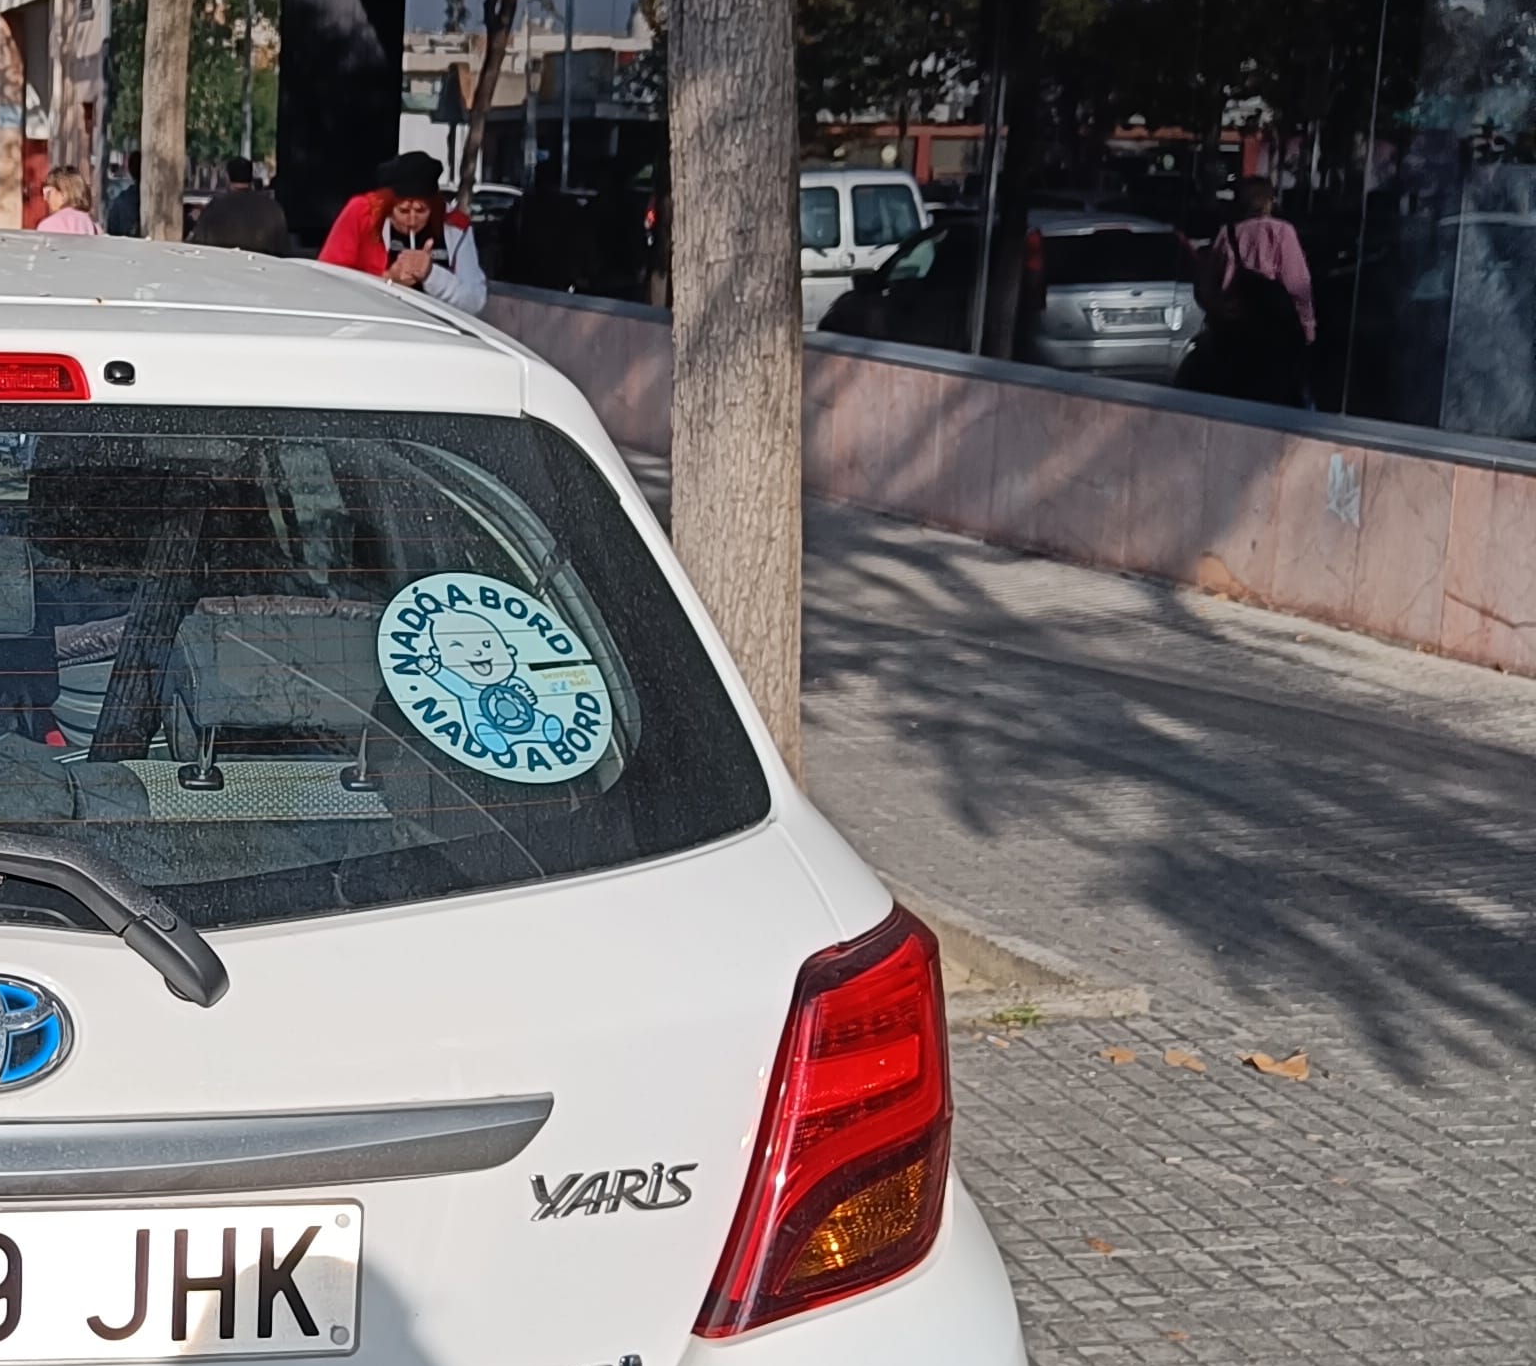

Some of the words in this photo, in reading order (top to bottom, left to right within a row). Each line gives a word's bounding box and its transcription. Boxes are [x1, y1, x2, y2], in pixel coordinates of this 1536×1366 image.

[446, 584, 473, 607] A
[479, 585, 574, 655] BORD
[526, 746, 552, 772] A
[548, 691, 601, 765] BORD
[86, 1225, 323, 1341] JHK
